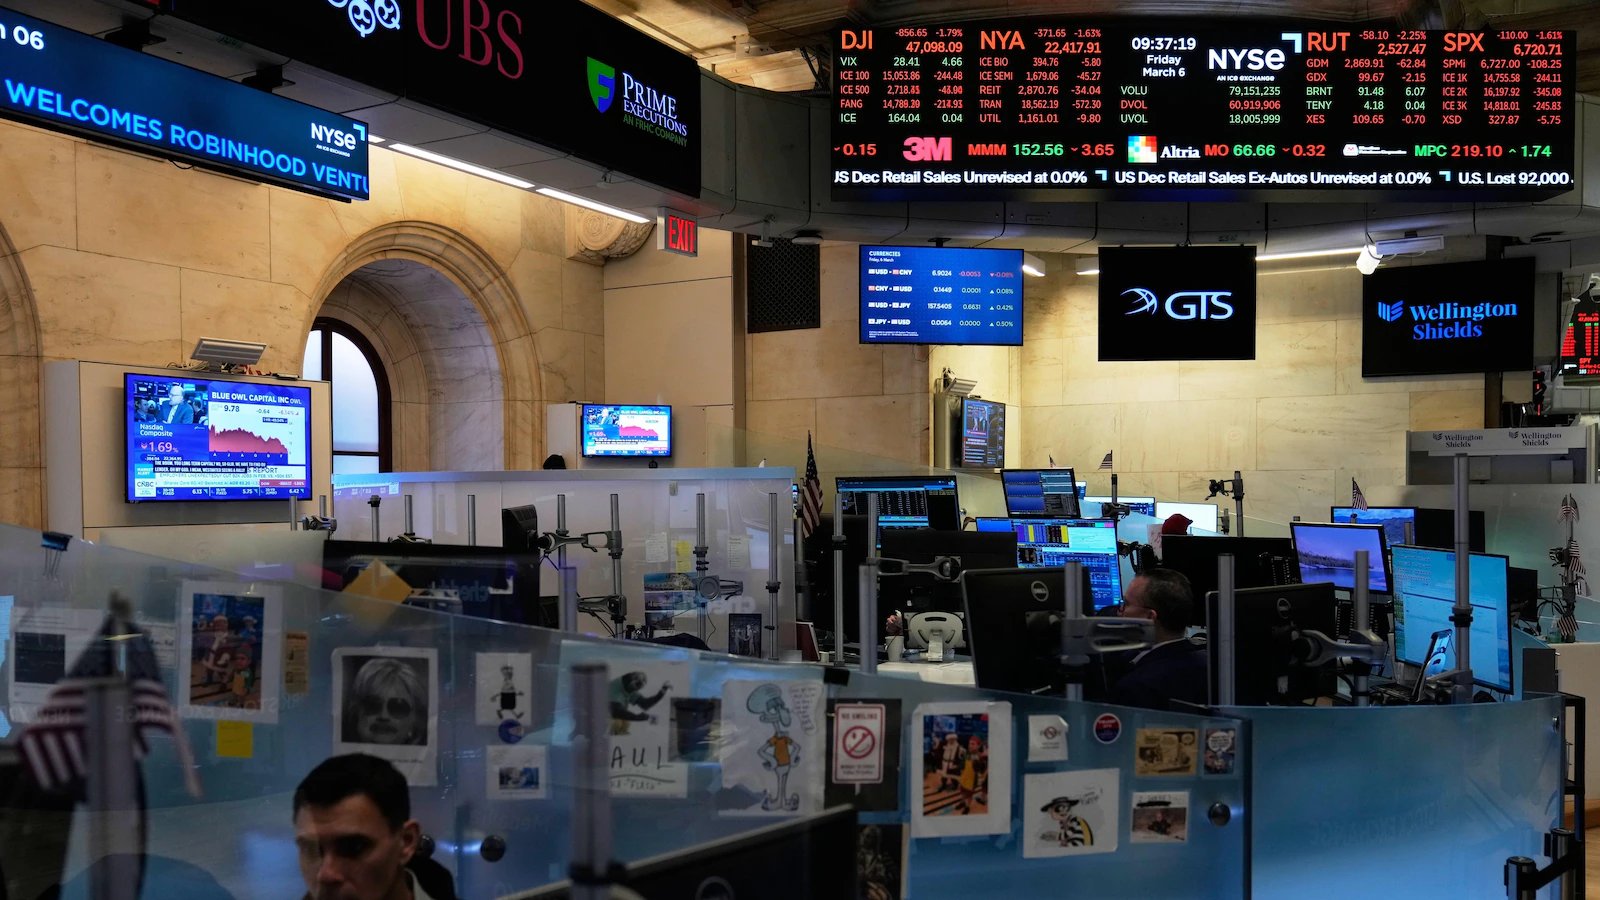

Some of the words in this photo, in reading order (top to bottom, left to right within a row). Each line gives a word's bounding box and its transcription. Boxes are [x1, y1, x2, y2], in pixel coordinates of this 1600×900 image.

[896, 28, 927, 37] -856.65
[936, 29, 963, 37] -1.79%
[1034, 29, 1066, 37] -371.65
[1074, 29, 1101, 37] -1.63%
[1359, 31, 1389, 40] -58.10
[1397, 31, 1426, 40] -2.25%
[1497, 31, 1528, 39] -110.00
[1536, 31, 1562, 39] -1.61%
[12, 26, 44, 51] 06
[416, 0, 524, 79] UBS
[842, 30, 872, 49] DJI
[981, 31, 1025, 49] NYA
[1132, 37, 1196, 50] 09:37:19
[1308, 32, 1350, 51] RUT
[1444, 33, 1484, 52] SPX
[906, 42, 963, 54] 47,098.09
[1045, 42, 1101, 54] 22,417.91
[1378, 43, 1426, 55] 2,527.47
[1514, 44, 1562, 56] 6,720.71
[840, 57, 857, 65] VIX
[894, 57, 920, 66] 28.41
[942, 57, 962, 66] 4.66
[980, 57, 992, 66] ICE
[994, 57, 1008, 66] BIO
[1033, 58, 1058, 66] 394.76
[1082, 58, 1101, 66] -5.80
[1147, 55, 1181, 65] Friday
[1307, 59, 1328, 67] GDM
[1345, 59, 1384, 68] 2,869.91
[1397, 59, 1426, 68] -62.84
[1443, 59, 1465, 68] SPMi
[1481, 59, 1520, 69] 6,727.00
[1527, 60, 1562, 68] -108.25
[841, 71, 853, 80] ICE
[856, 71, 869, 80] 100
[934, 71, 963, 80] -244.48
[980, 71, 992, 80] ICE
[994, 71, 1013, 80] SEMI
[1027, 72, 1059, 81] 1,679.06
[1077, 72, 1101, 80] -45.27
[1143, 67, 1175, 76] March
[1178, 68, 1185, 77] 6
[1306, 72, 1326, 81] GDX
[1359, 73, 1384, 82] 99.67
[1402, 73, 1426, 82] -2.15
[1443, 73, 1455, 82] ICE
[1458, 73, 1467, 82] 1K
[1484, 73, 1520, 83] 14,755.58
[1534, 74, 1561, 82] -244.11
[980, 85, 1001, 94] REIT
[1018, 86, 1058, 95] 2,870.76
[1071, 86, 1101, 95] -34.04
[1121, 86, 1147, 95] VOLU
[1230, 86, 1280, 96] 79,151,235
[1307, 87, 1333, 95] BRNT
[1358, 87, 1384, 96] 91.48
[1406, 87, 1425, 96] 6.07
[1443, 87, 1455, 96] ICE
[1457, 87, 1467, 96] 2K
[1484, 87, 1520, 97] 16,197.92
[1534, 88, 1561, 96] -345.08
[622, 72, 677, 119] PRIME
[980, 100, 1001, 108] TRAN
[1022, 100, 1058, 109] 18,562.19
[1072, 100, 1101, 109] -572.30
[1121, 100, 1147, 109] DVOL
[1230, 100, 1280, 110] 60,919,906
[1306, 101, 1332, 109] TENY
[1364, 101, 1384, 110] 4.18
[1405, 101, 1425, 110] 0.04
[623, 102, 687, 137] EXECUTIONS
[841, 113, 856, 122] ICE
[889, 113, 920, 122] 164.04
[942, 114, 962, 122] 0.04
[980, 114, 1001, 122] UTIL
[1019, 114, 1058, 123] 1,161.01
[1077, 114, 1101, 123] -9.80
[1121, 114, 1148, 123] UVOL
[1230, 114, 1280, 124] 18,005,999
[1306, 115, 1325, 123] XES
[1353, 115, 1384, 124] 109.65
[1402, 115, 1425, 124] -0.70
[1443, 115, 1462, 124] XSD
[1489, 115, 1519, 124] 327.87
[1537, 116, 1561, 124] -5.75
[5, 78, 163, 141] WELCOMES
[170, 124, 306, 177] ROBINHOOD
[623, 114, 633, 127] AN
[635, 116, 654, 134] FRHC
[655, 126, 688, 148] COMPANY
[843, 144, 876, 155] 0.15
[903, 137, 952, 161] 3M
[968, 144, 1006, 155] MMM
[1013, 144, 1063, 155] 152.56
[1082, 144, 1114, 156] 3.65
[1160, 145, 1201, 158] Altria
[1205, 144, 1229, 156] MO
[1233, 145, 1275, 156] 66.66
[1293, 145, 1325, 156] 0.32
[1415, 145, 1447, 156] MPC
[1451, 145, 1502, 157] 219.10
[1521, 146, 1551, 157] 1.74
[852, 171, 880, 183] Dec
[883, 171, 921, 183] Retail
[923, 171, 961, 183] Sales
[964, 171, 1031, 183] Unrevised
[1034, 172, 1048, 183] at
[1050, 171, 1087, 183] 0.0%
[1115, 171, 1136, 183] US
[1138, 171, 1166, 183] Dec
[1169, 171, 1206, 183] Retail
[1209, 171, 1246, 183] Sales
[1249, 172, 1308, 183] Ex-Autos
[1310, 172, 1377, 184] Unrevised
[1379, 173, 1393, 184] at
[1395, 172, 1431, 184] 0.0%
[1459, 172, 1484, 184] U.S.
[1487, 172, 1516, 184] Lost
[1518, 172, 1569, 186] 92,000
[668, 215, 694, 252] EXIT
[1165, 291, 1233, 320] GTS
[1410, 302, 1517, 321] Wellington
[1413, 321, 1482, 340] Shields
[232, 393, 248, 401] OWL
[249, 394, 276, 403] CAPITAL
[1446, 440, 1471, 448] Shields
[611, 746, 674, 770] AUL
